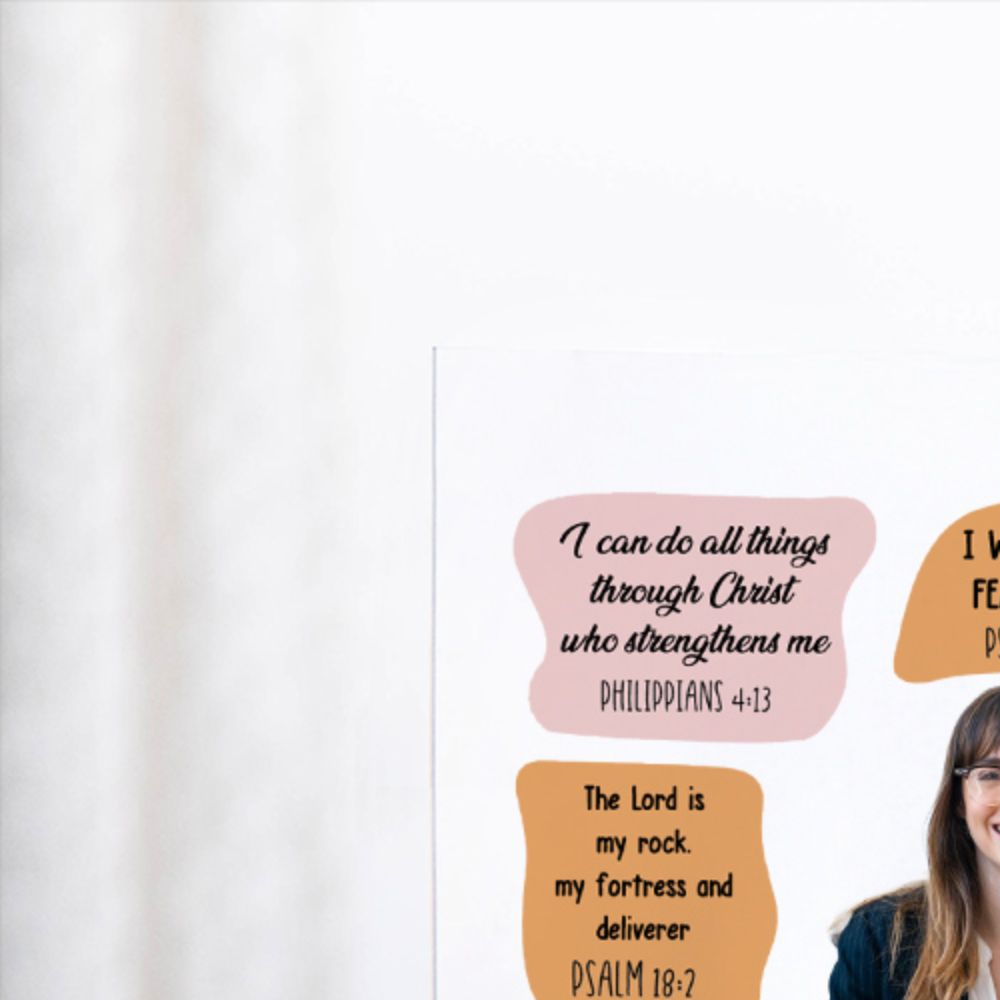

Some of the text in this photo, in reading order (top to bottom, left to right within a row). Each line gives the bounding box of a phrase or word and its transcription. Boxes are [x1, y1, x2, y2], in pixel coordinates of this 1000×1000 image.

[559, 521, 831, 567] I can do all things
[963, 529, 975, 561] I
[589, 571, 801, 617] through Christ
[560, 623, 831, 667] who strengthens me
[601, 679, 771, 713] PHILIPPIANS 4:13
[583, 784, 705, 811] The Lord is
[596, 828, 691, 862] my rock.
[555, 871, 733, 905] my fortress and
[595, 915, 691, 941] deliverer
[571, 959, 696, 998] PSALM 18:2
